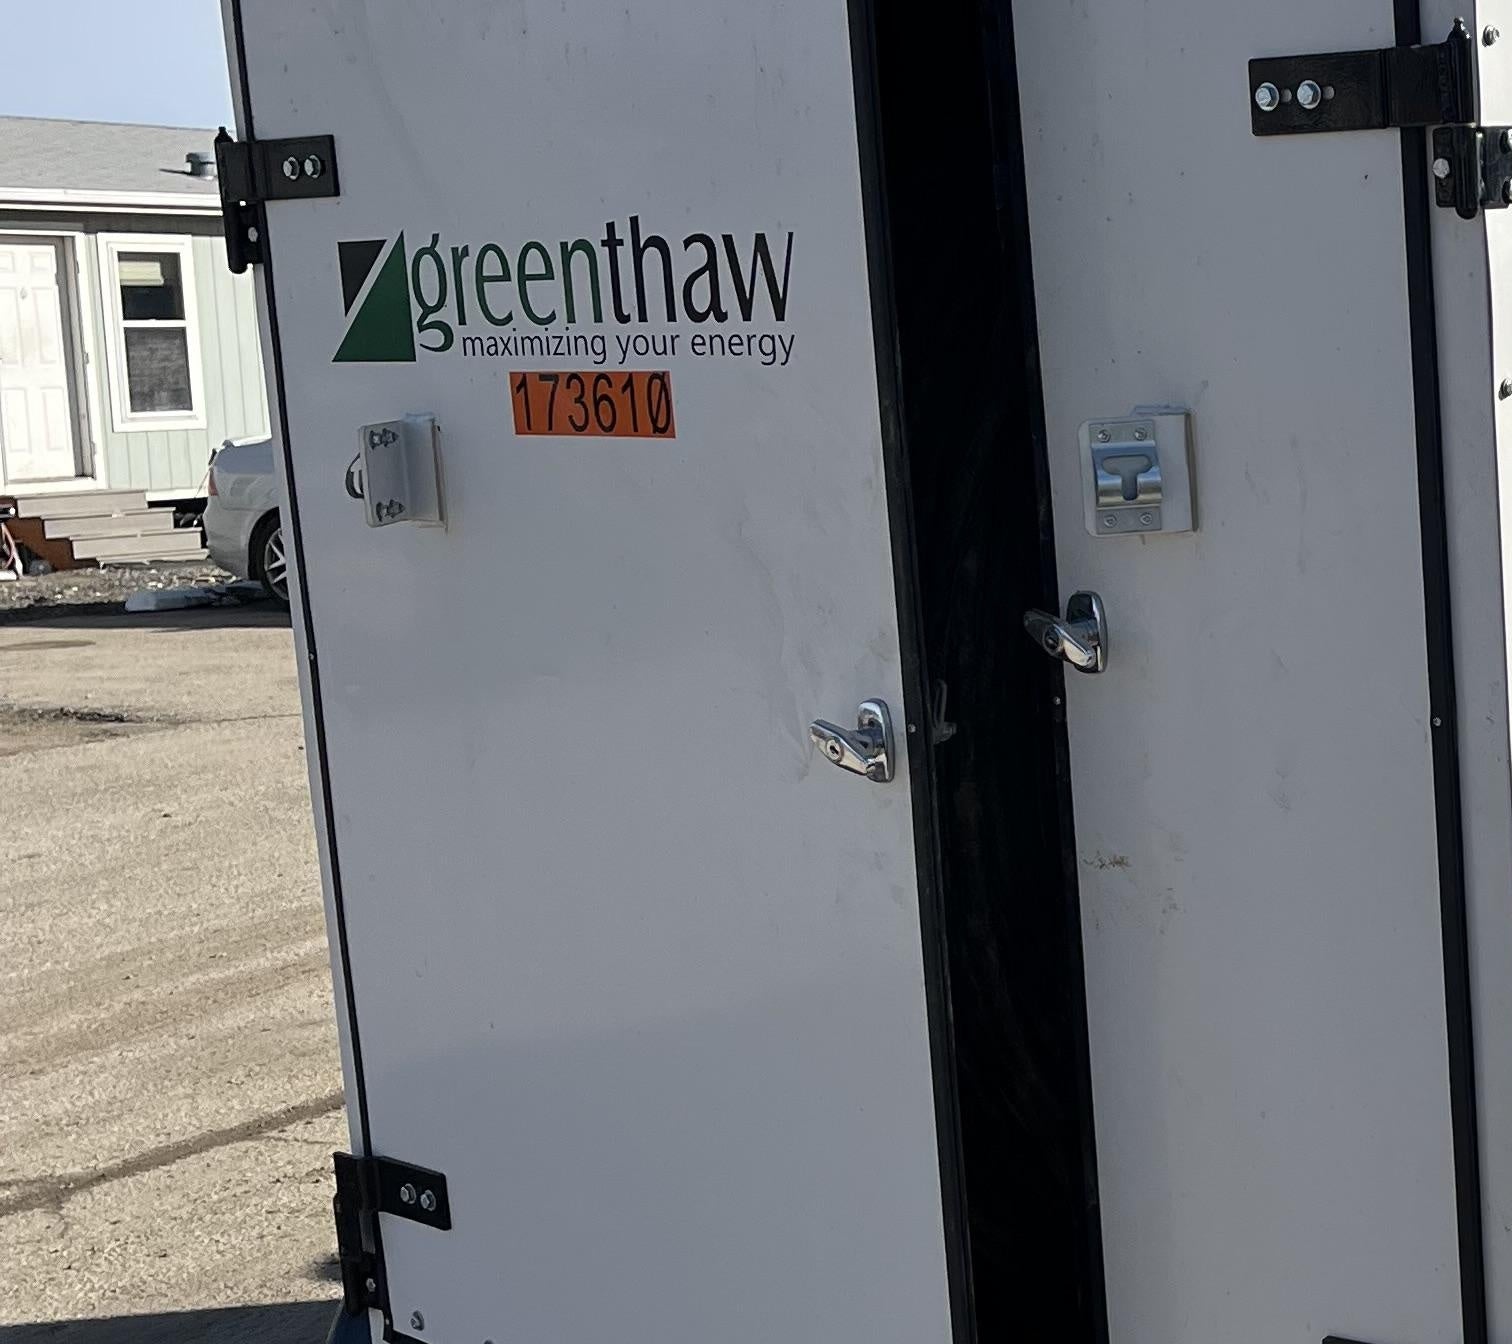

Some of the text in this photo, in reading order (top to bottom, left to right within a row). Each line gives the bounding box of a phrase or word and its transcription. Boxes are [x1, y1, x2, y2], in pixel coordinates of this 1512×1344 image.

[411, 214, 794, 353] greenthaw
[461, 327, 795, 366] maximizing your energy
[514, 372, 672, 434] 173610
